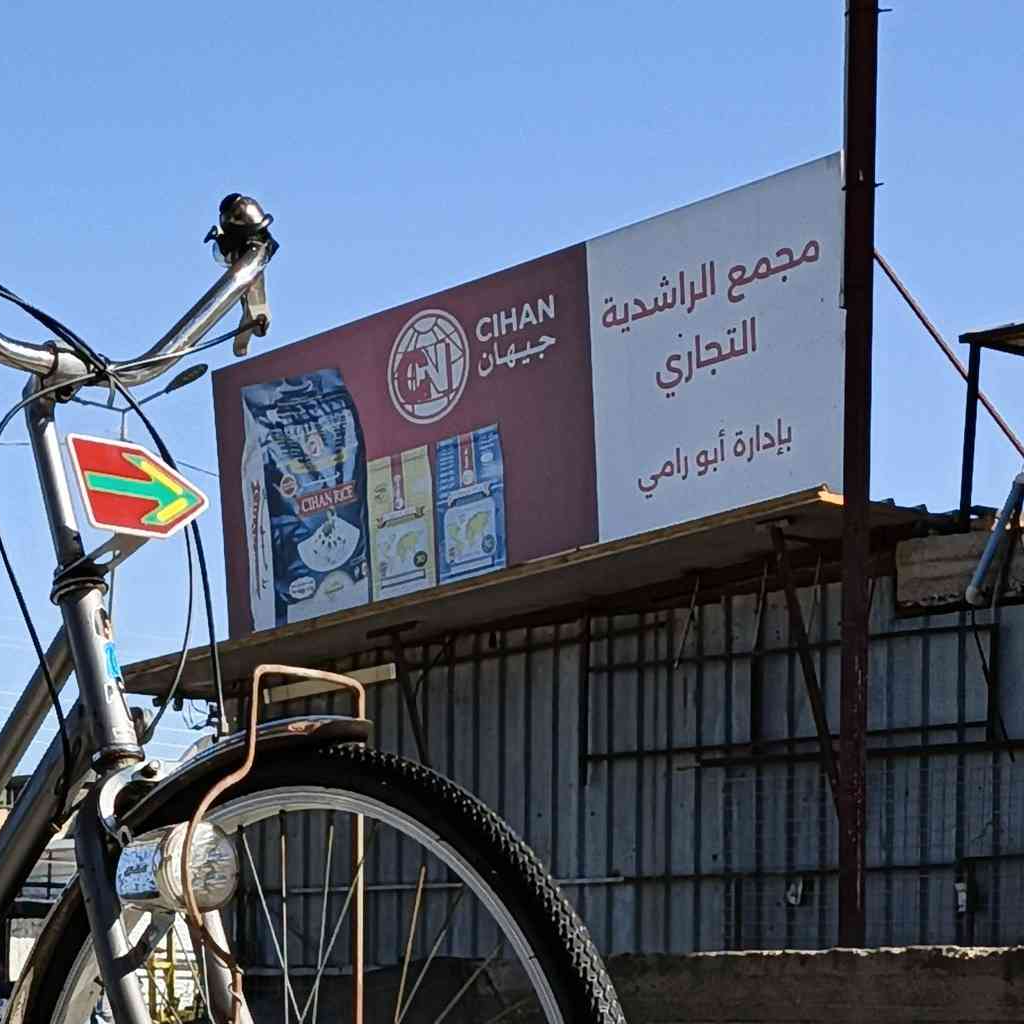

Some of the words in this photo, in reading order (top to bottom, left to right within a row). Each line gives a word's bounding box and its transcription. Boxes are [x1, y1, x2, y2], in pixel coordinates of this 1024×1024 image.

[728, 239, 820, 303] مجمع
[475, 294, 555, 342] CIHAN
[602, 260, 716, 333] الراشدية
[478, 335, 556, 377] جيهان
[656, 316, 757, 398] التجاري
[695, 428, 725, 476] أبو
[733, 418, 792, 462] بإدارة
[637, 447, 688, 499] رامي
